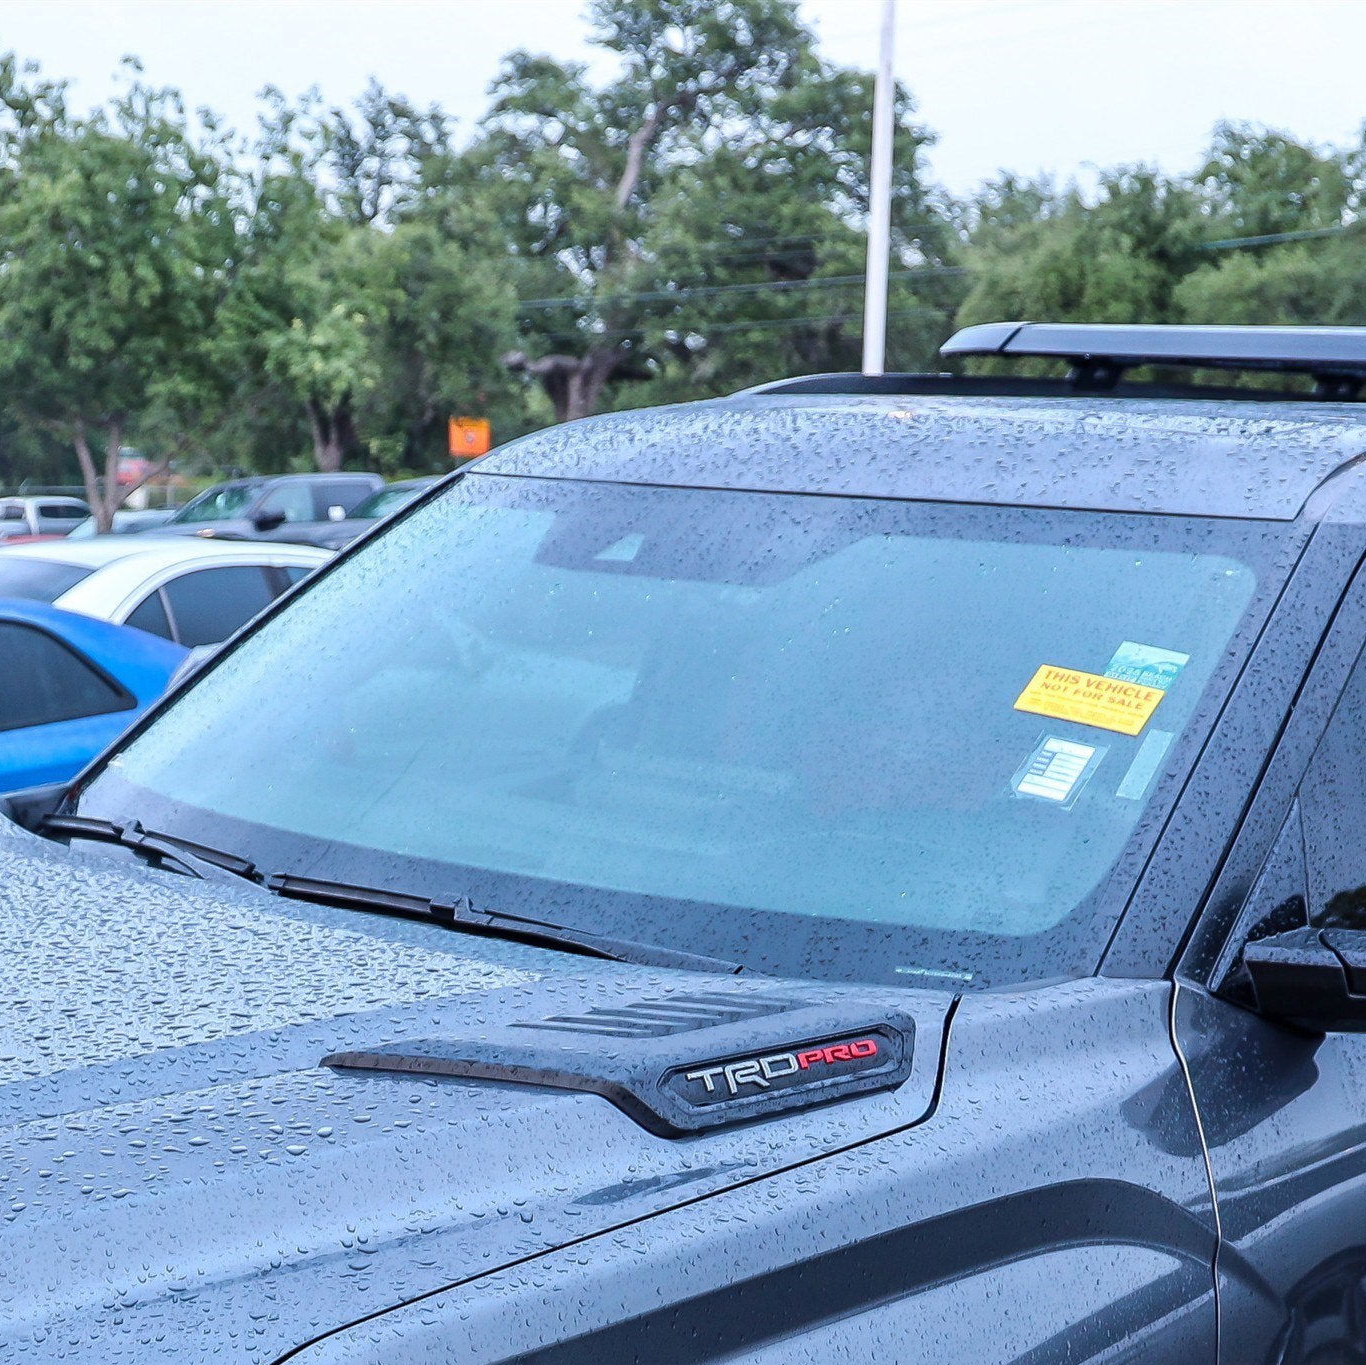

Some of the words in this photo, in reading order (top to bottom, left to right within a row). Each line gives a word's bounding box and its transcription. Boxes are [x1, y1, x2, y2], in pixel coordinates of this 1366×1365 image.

[1039, 681, 1069, 693] NOT
[1072, 688, 1104, 701] FOR
[1107, 696, 1146, 710] SALE
[1043, 669, 1081, 685] THIS
[1085, 677, 1157, 702] VEHICLE
[686, 1053, 799, 1095] TRD
[798, 1038, 878, 1070] PRO
